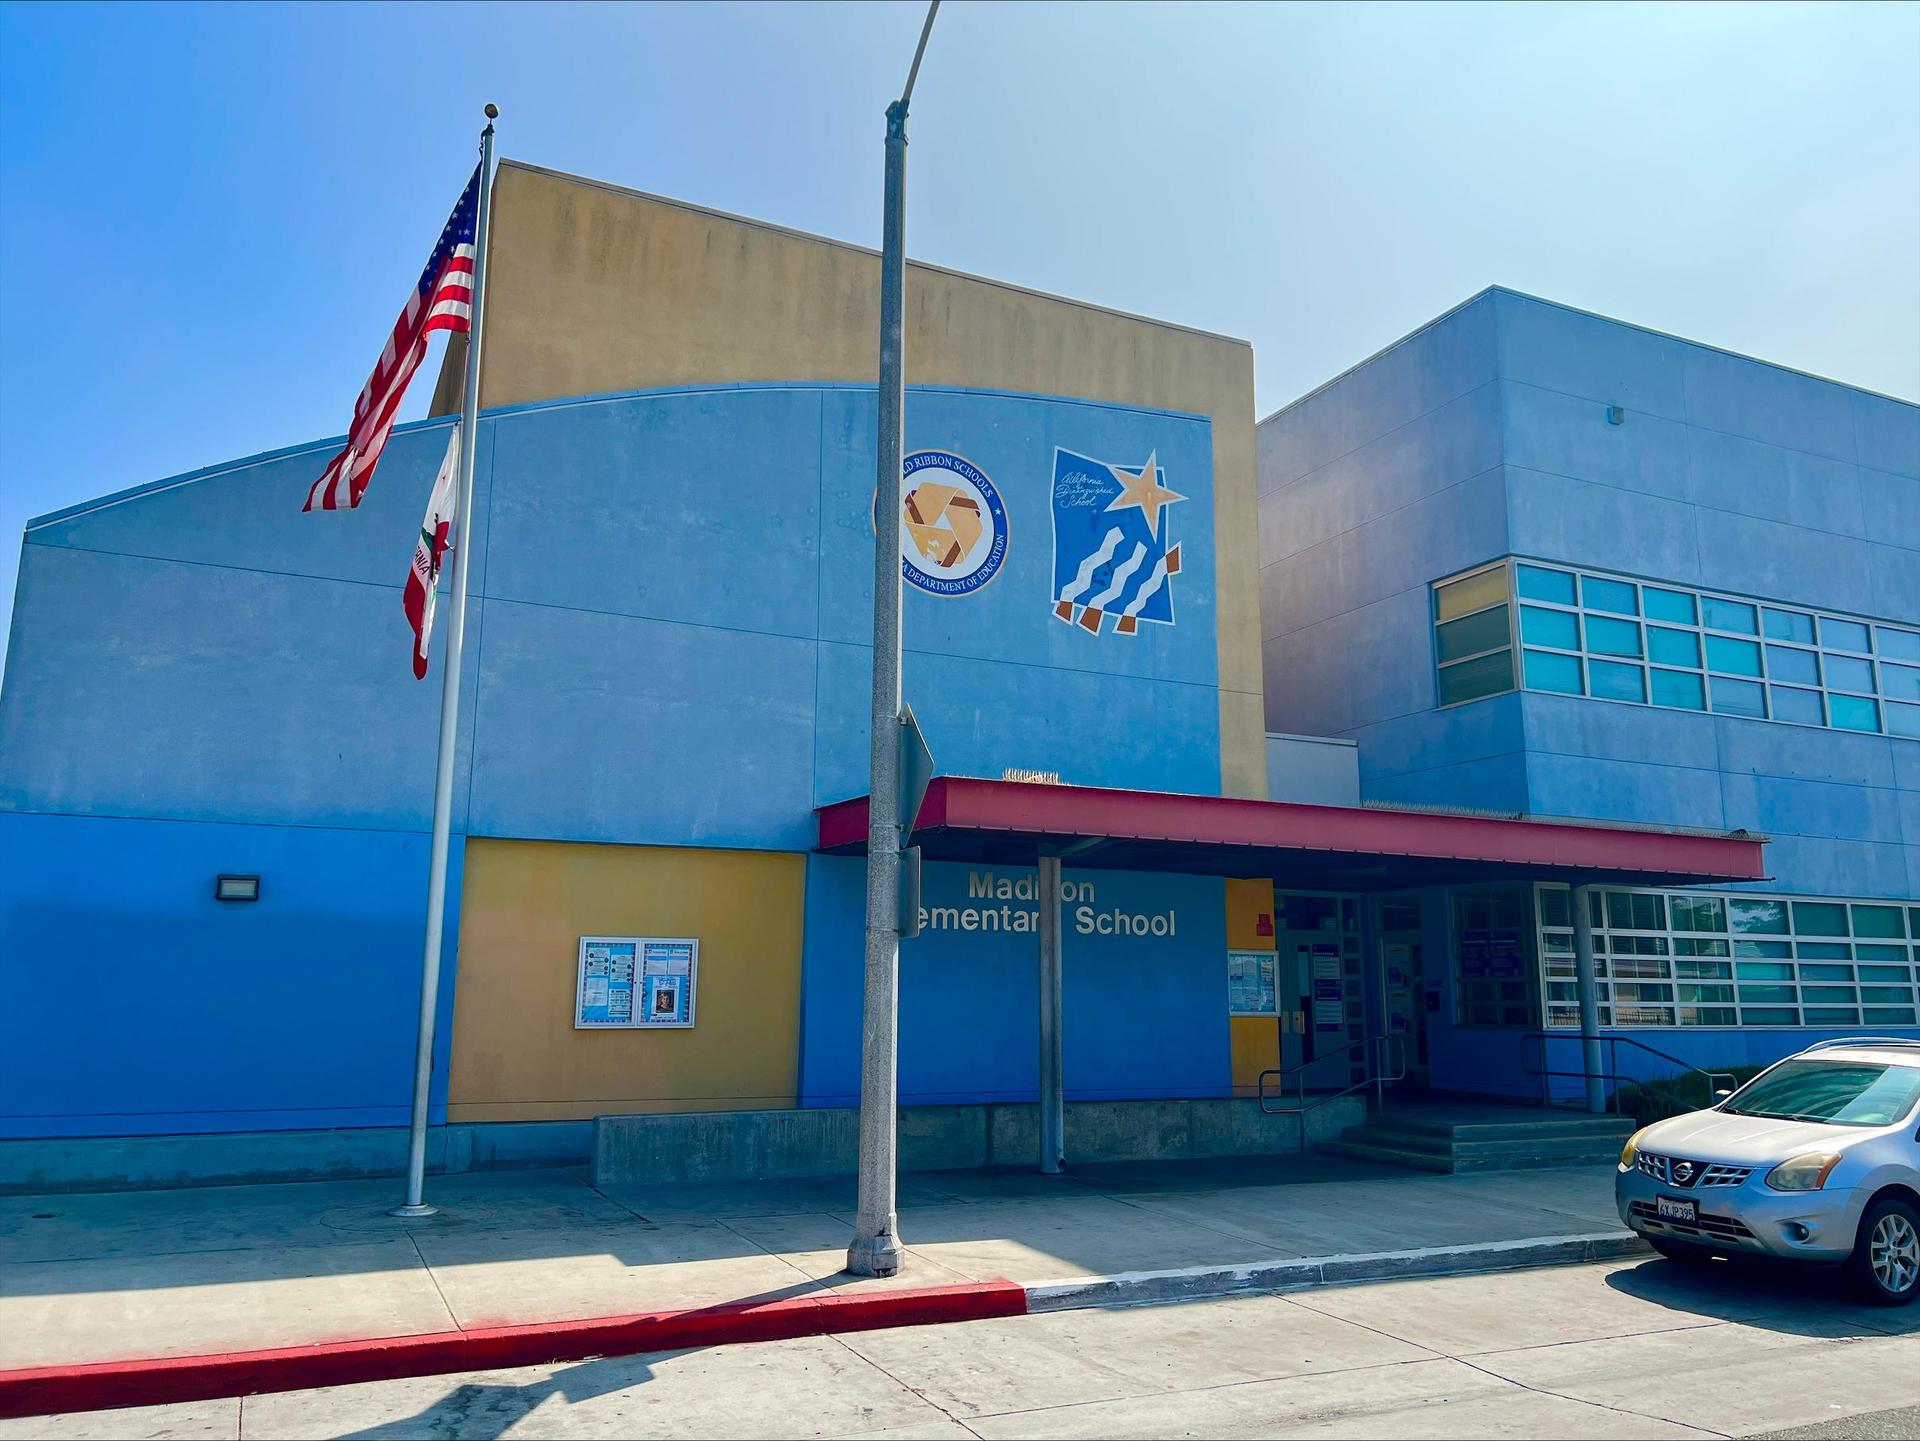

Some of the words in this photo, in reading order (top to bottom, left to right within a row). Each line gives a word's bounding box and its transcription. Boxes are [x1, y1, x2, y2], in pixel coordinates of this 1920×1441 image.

[914, 455, 952, 468] RIBBON
[953, 461, 994, 498] SCHOOLS
[1060, 494, 1097, 509] School
[907, 568, 966, 592] DEPARTMENT
[966, 575, 979, 588] OF
[978, 534, 1005, 580] EDUCATION
[968, 871, 1096, 903] Madion
[918, 906, 1041, 932] ementar
[1075, 905, 1176, 936] School
